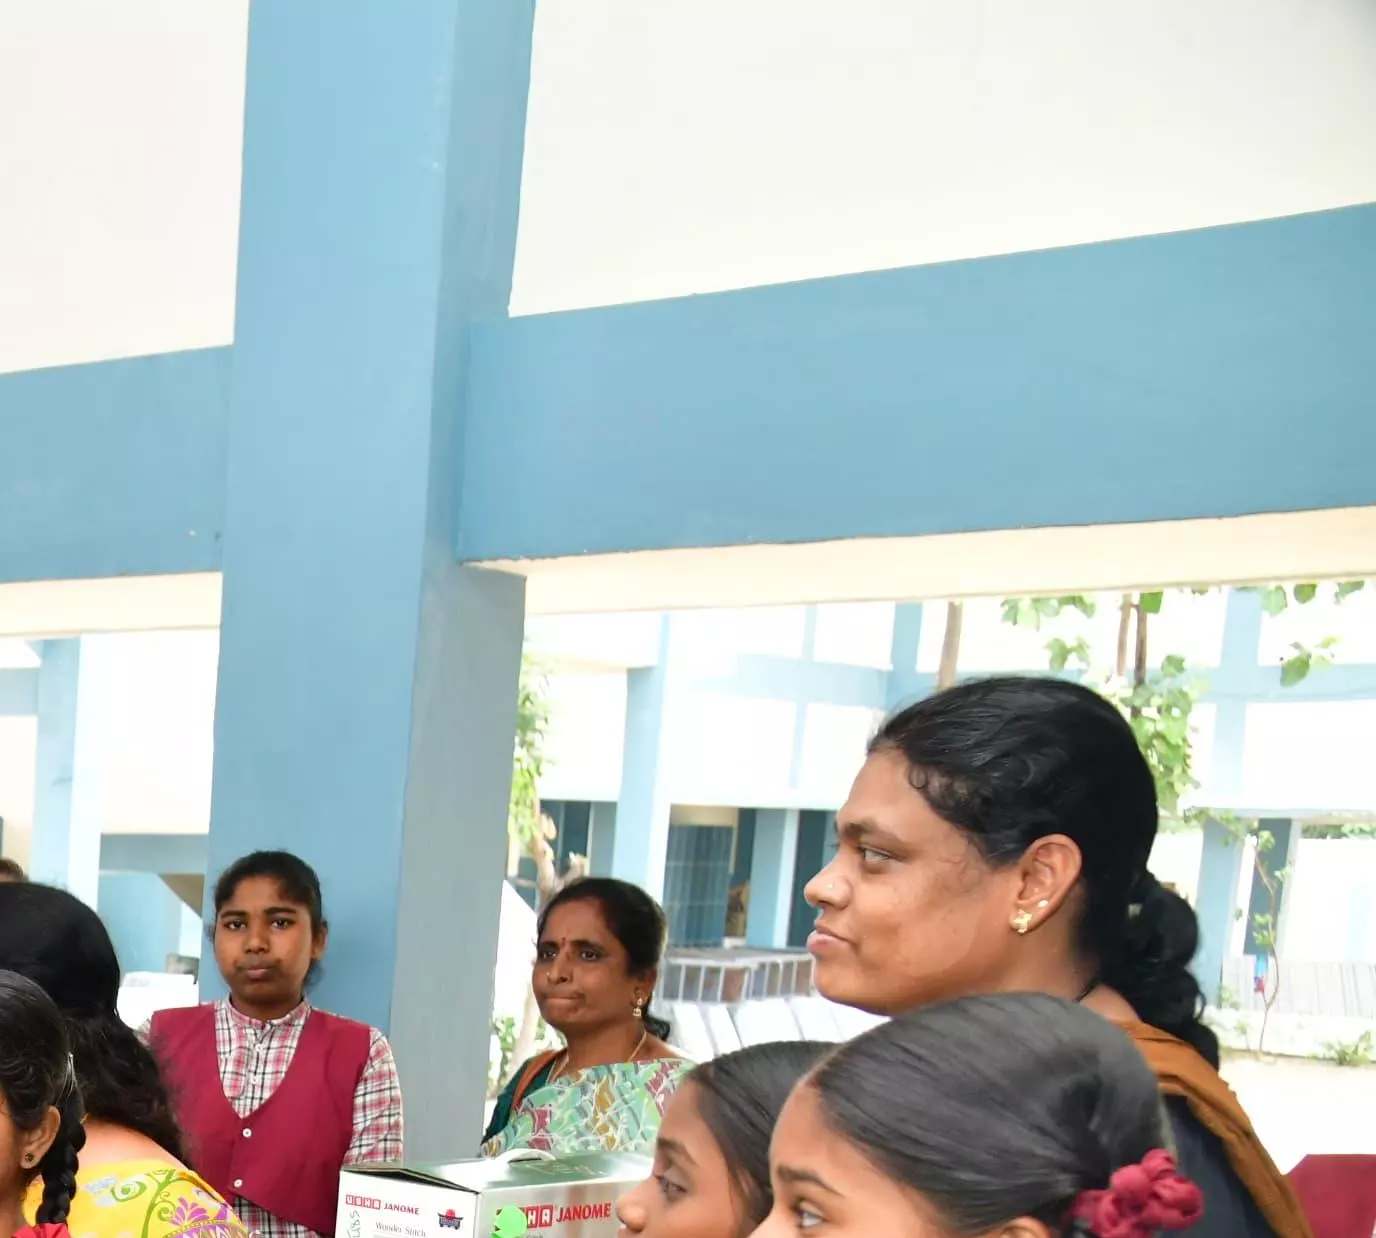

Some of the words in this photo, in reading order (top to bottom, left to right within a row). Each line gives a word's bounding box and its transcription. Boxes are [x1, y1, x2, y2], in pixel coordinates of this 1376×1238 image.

[384, 1202, 419, 1215] JANOME
[556, 1203, 611, 1222] JANOME
[376, 1221, 402, 1233] Wonder
[405, 1227, 426, 1238] Stitch
